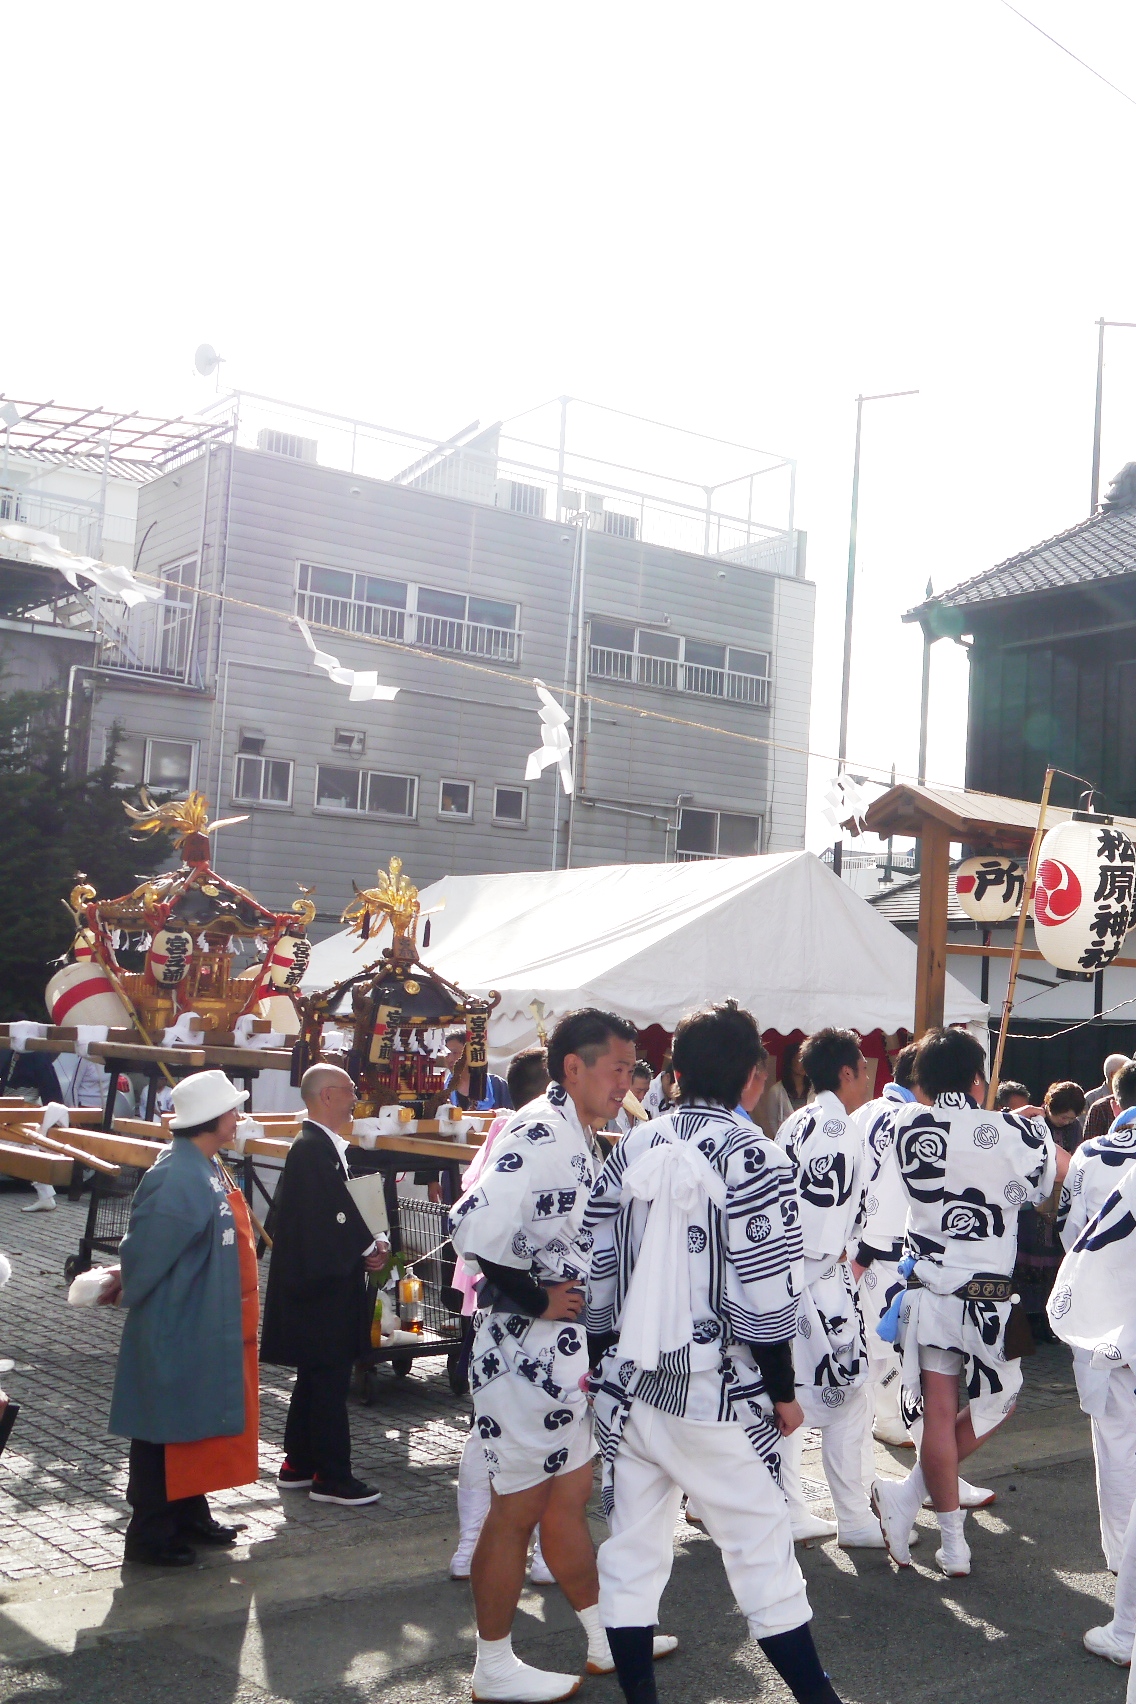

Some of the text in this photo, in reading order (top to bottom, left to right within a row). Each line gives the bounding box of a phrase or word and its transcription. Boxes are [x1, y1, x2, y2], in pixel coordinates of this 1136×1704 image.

[973, 859, 1025, 908] 所
[1077, 828, 1136, 970] 松原神社
[162, 935, 190, 983] 宮之前
[284, 941, 312, 986] 宮之前
[378, 1009, 400, 1060] 宮之前
[470, 1015, 487, 1063] 宮之前
